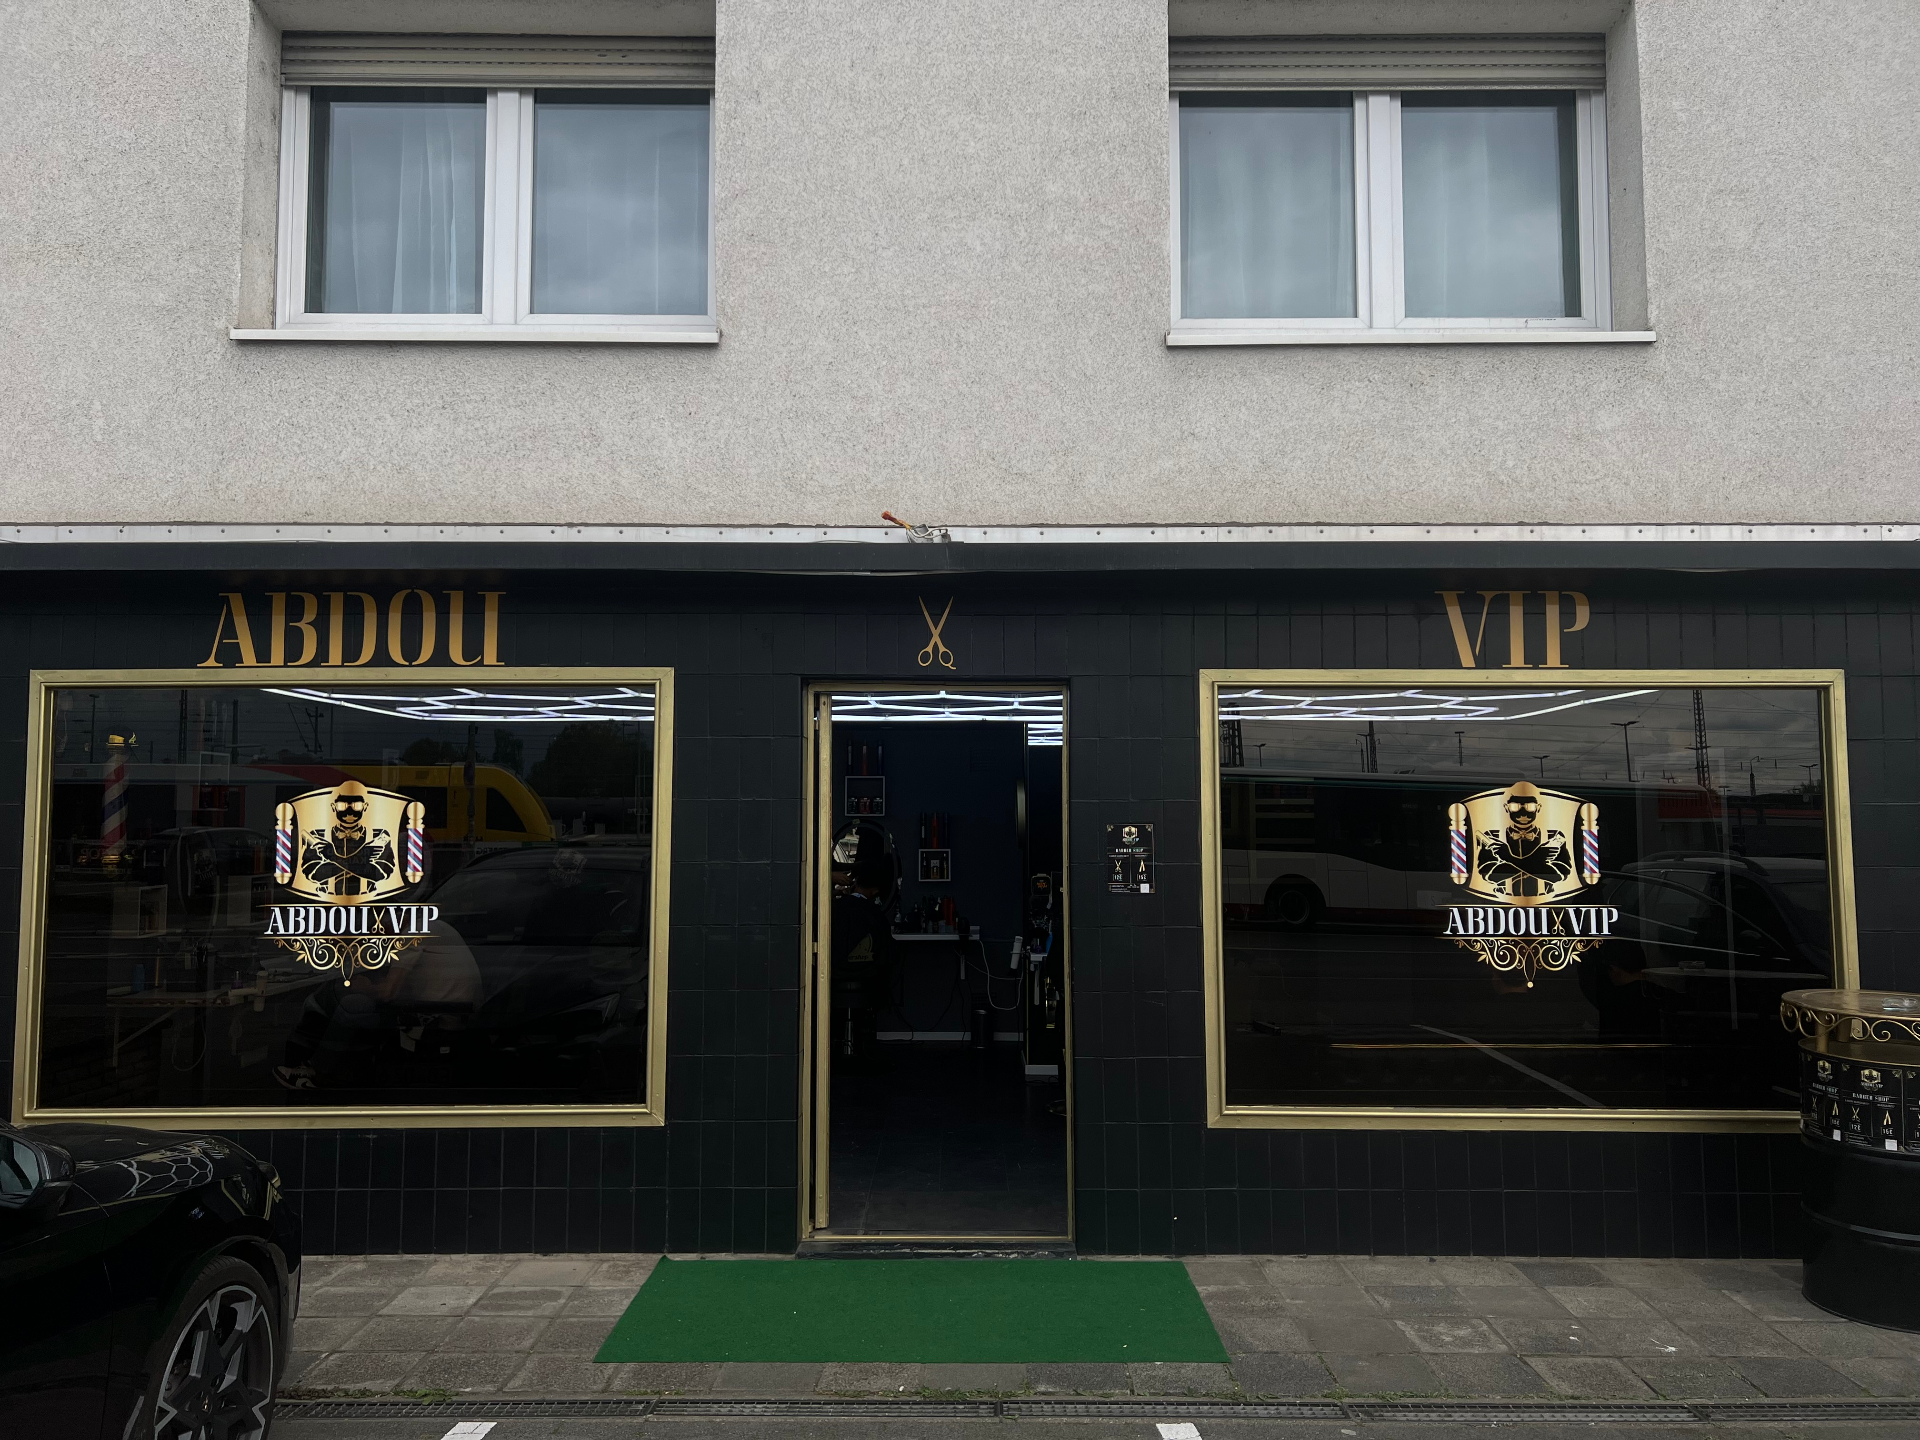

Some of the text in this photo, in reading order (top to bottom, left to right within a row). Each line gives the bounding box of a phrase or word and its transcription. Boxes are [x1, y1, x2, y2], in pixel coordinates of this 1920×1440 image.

[197, 588, 507, 667] ABDOU
[1434, 590, 1591, 668] VIP
[263, 905, 439, 935] ABDOU VIP
[1443, 907, 1619, 936] ABDOU VIP
